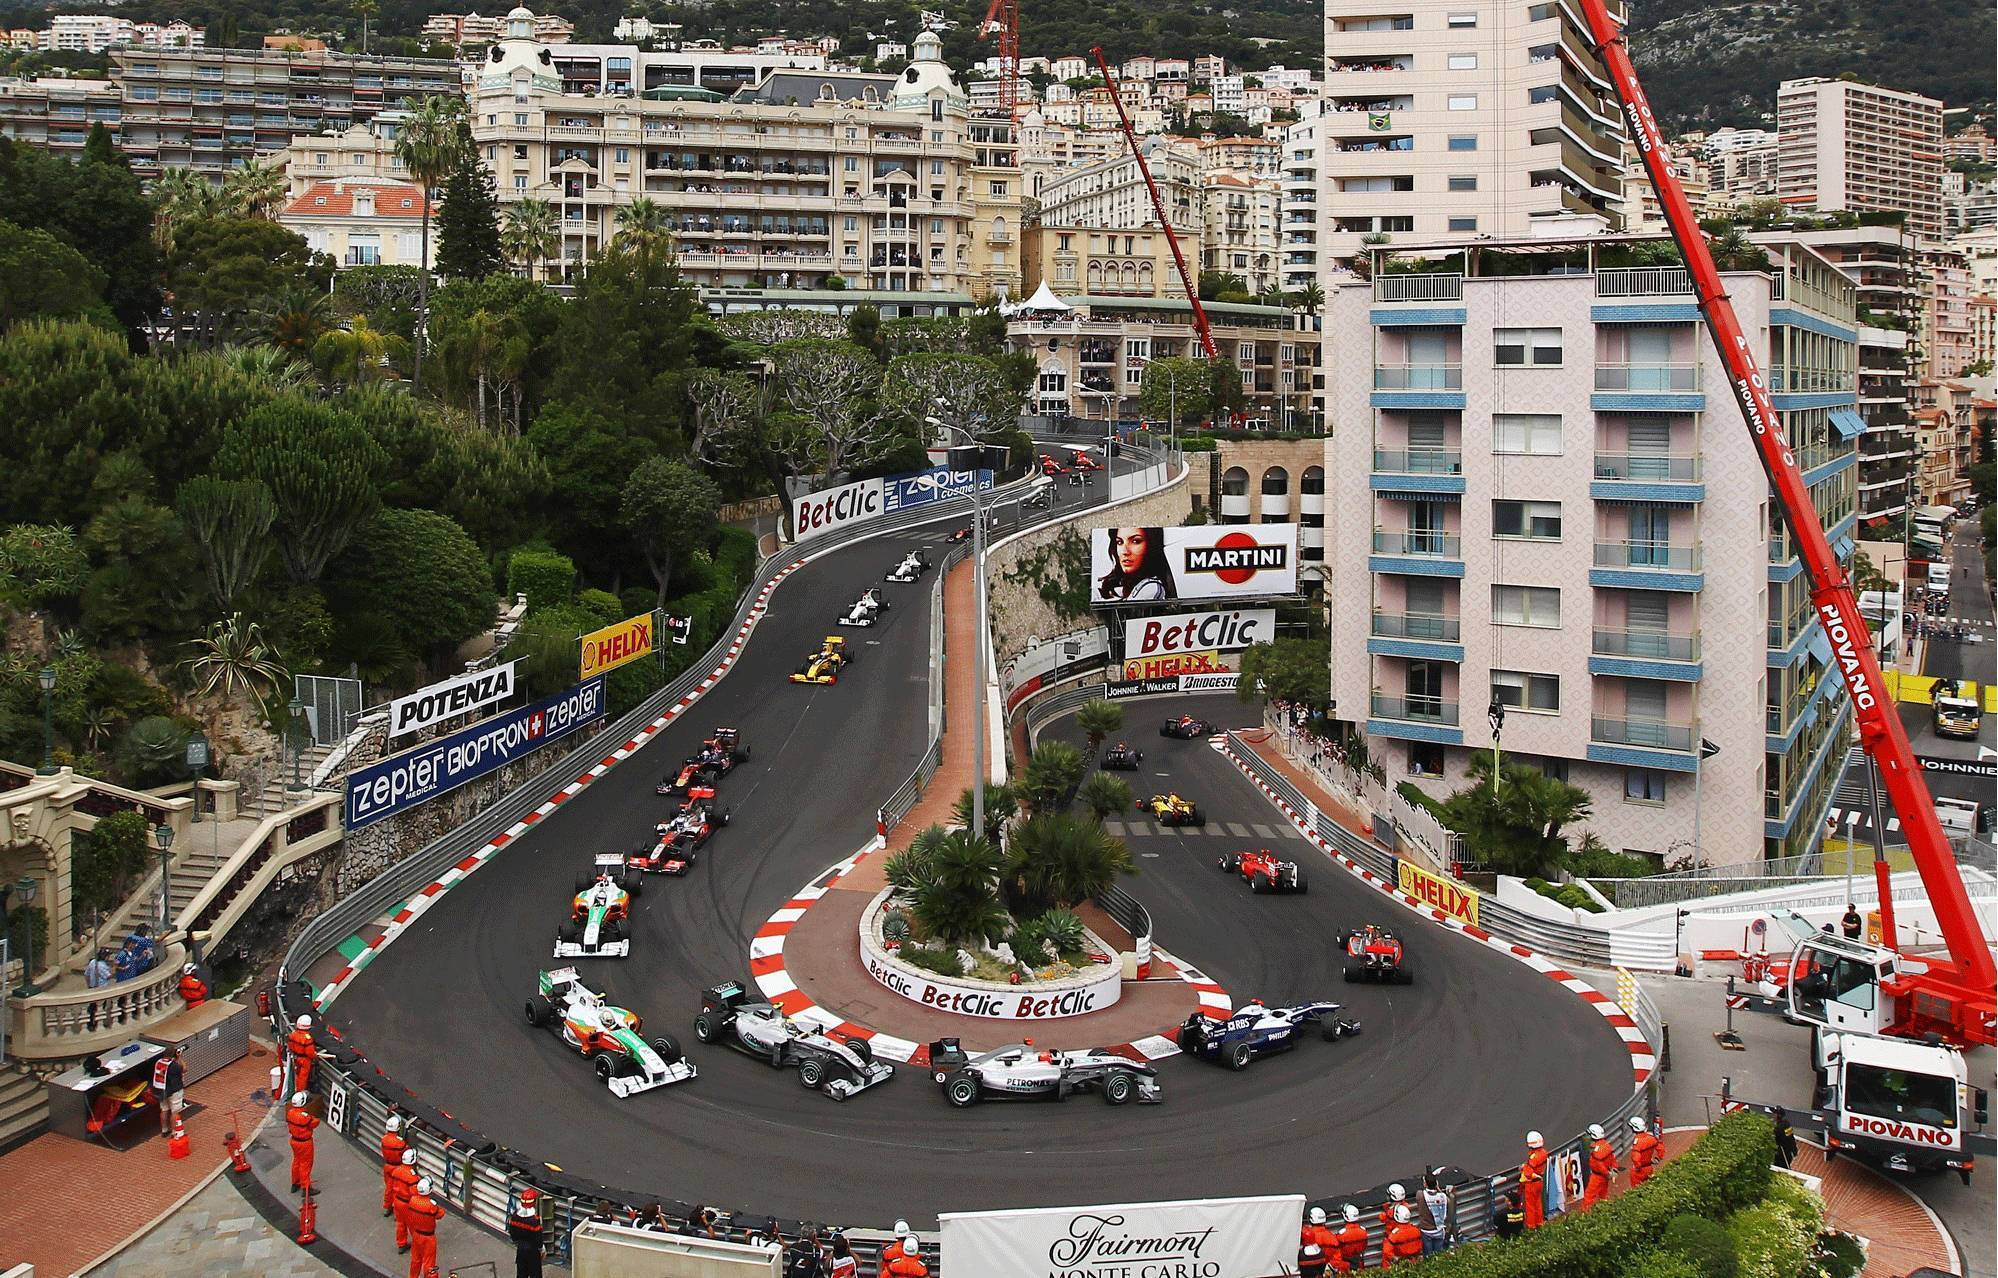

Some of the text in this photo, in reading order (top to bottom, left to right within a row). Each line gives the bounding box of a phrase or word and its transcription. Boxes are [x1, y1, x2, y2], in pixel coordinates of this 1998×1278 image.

[1626, 102, 1652, 152] PIOVANO
[1629, 76, 1676, 178] PIOVANO
[1735, 336, 1794, 467] PIOVANO
[1737, 379, 1766, 435] PIOVANO
[799, 483, 879, 534] BetClic
[1190, 549, 1281, 568] MARTINI
[598, 622, 651, 667] HELIX
[1141, 612, 1258, 654] BetClic
[1821, 604, 1875, 711] PIOVANO
[398, 670, 508, 730] POTENZA
[1108, 682, 1177, 697] JOHNNIE WALKER
[447, 716, 530, 776] BIOPTRON
[353, 751, 444, 812] zepter
[405, 783, 438, 800] MEDICAL
[1413, 871, 1476, 924] HELIX
[870, 959, 911, 996] BetClic
[921, 984, 1003, 1016] BetClic
[1015, 989, 1095, 1018] BetClic
[1236, 1018, 1250, 1030] RBS
[1007, 1078, 1050, 1088] PETRONAS
[1849, 1116, 1953, 1146] PIOVANO
[1049, 1214, 1219, 1268] Fairmont
[1141, 1261, 1220, 1278] CARLO
